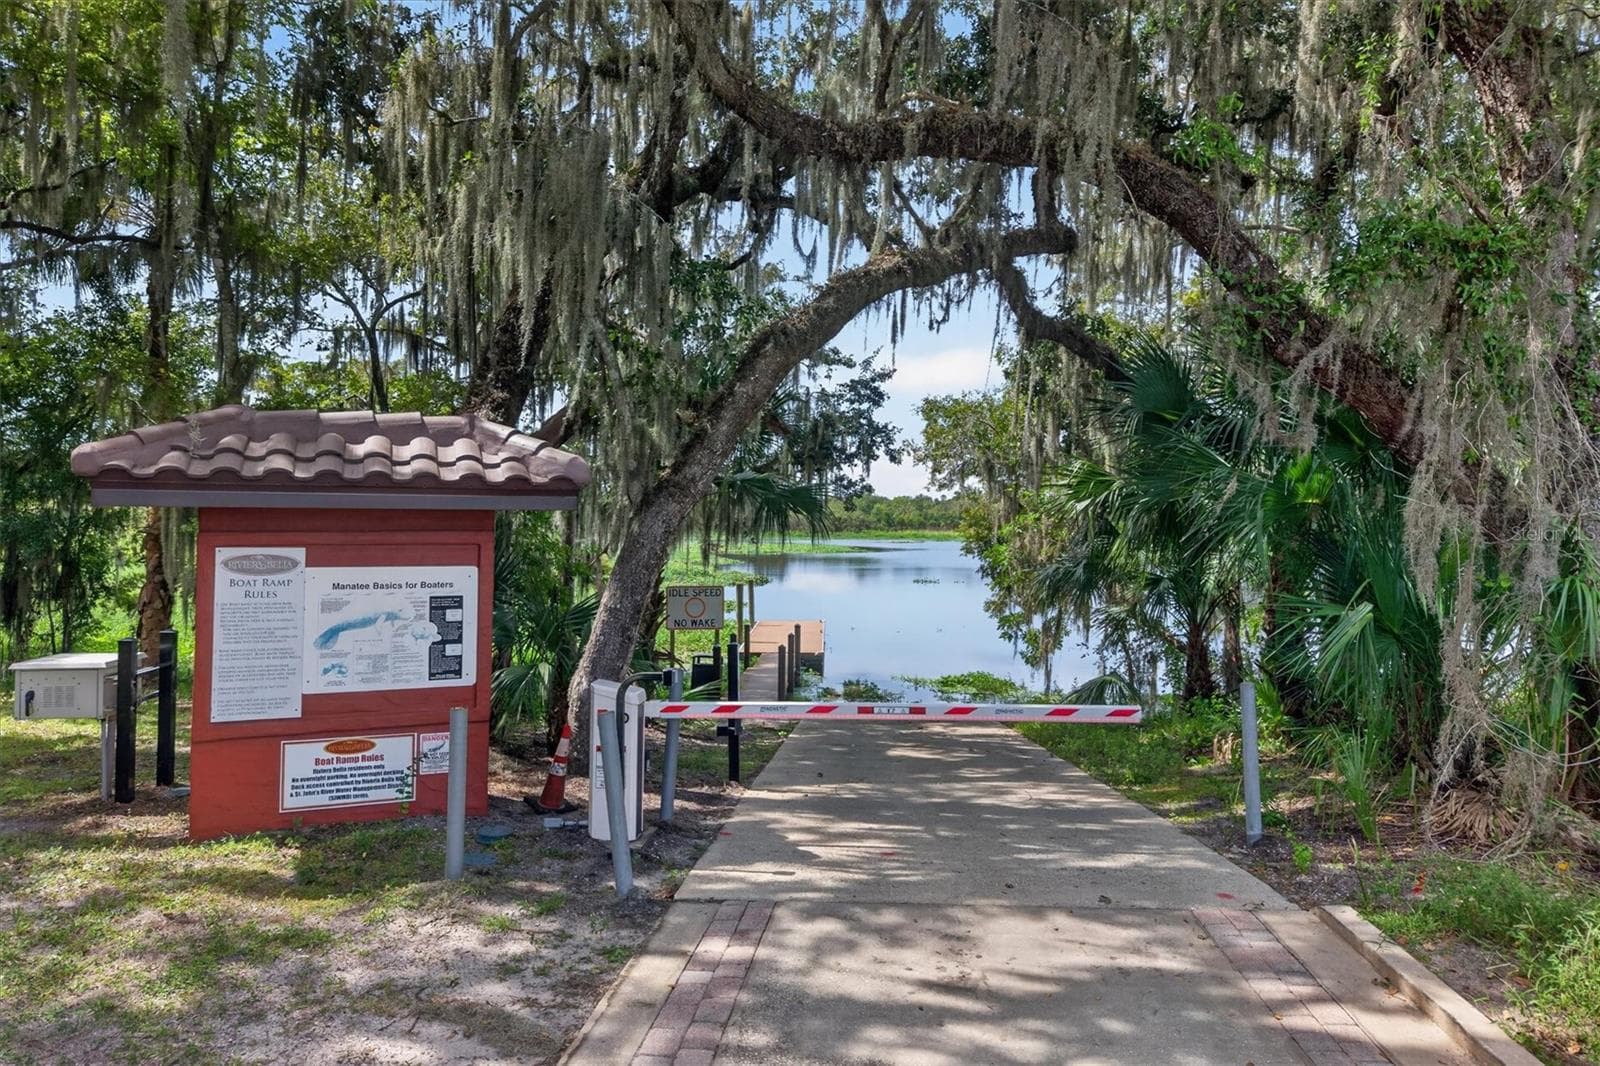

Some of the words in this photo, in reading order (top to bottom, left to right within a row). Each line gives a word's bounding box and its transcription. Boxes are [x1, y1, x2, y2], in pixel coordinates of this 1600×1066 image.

[229, 578, 257, 588] BOAT
[262, 578, 294, 588] RAMP
[332, 582, 370, 590] Manatee
[372, 581, 403, 590] Basics
[405, 581, 418, 589] for
[420, 581, 454, 589] Boaters
[244, 590, 279, 599] RULES
[669, 588, 690, 598] IDLE
[692, 588, 722, 598] SPEED
[673, 618, 688, 628] NO
[690, 618, 717, 628] WAKE
[314, 757, 335, 766] Boat
[336, 755, 360, 765] Ramp
[361, 753, 385, 763] Rules
